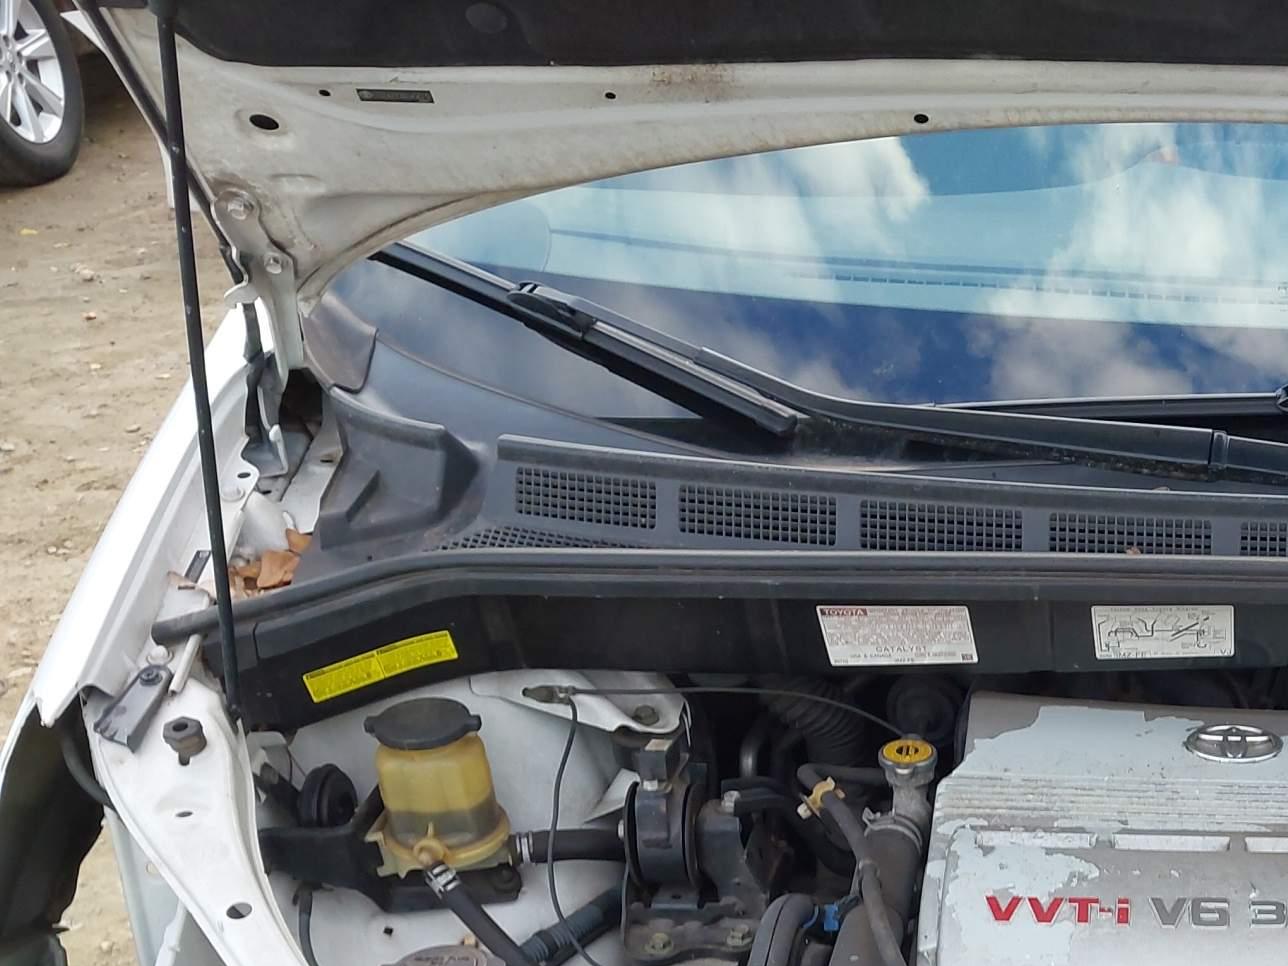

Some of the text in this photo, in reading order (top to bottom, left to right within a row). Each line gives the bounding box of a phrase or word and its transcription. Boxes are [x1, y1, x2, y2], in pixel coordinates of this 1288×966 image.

[823, 608, 865, 616] TOYOTA
[985, 895, 1131, 926] VVT-i
[1149, 896, 1230, 928] V6
